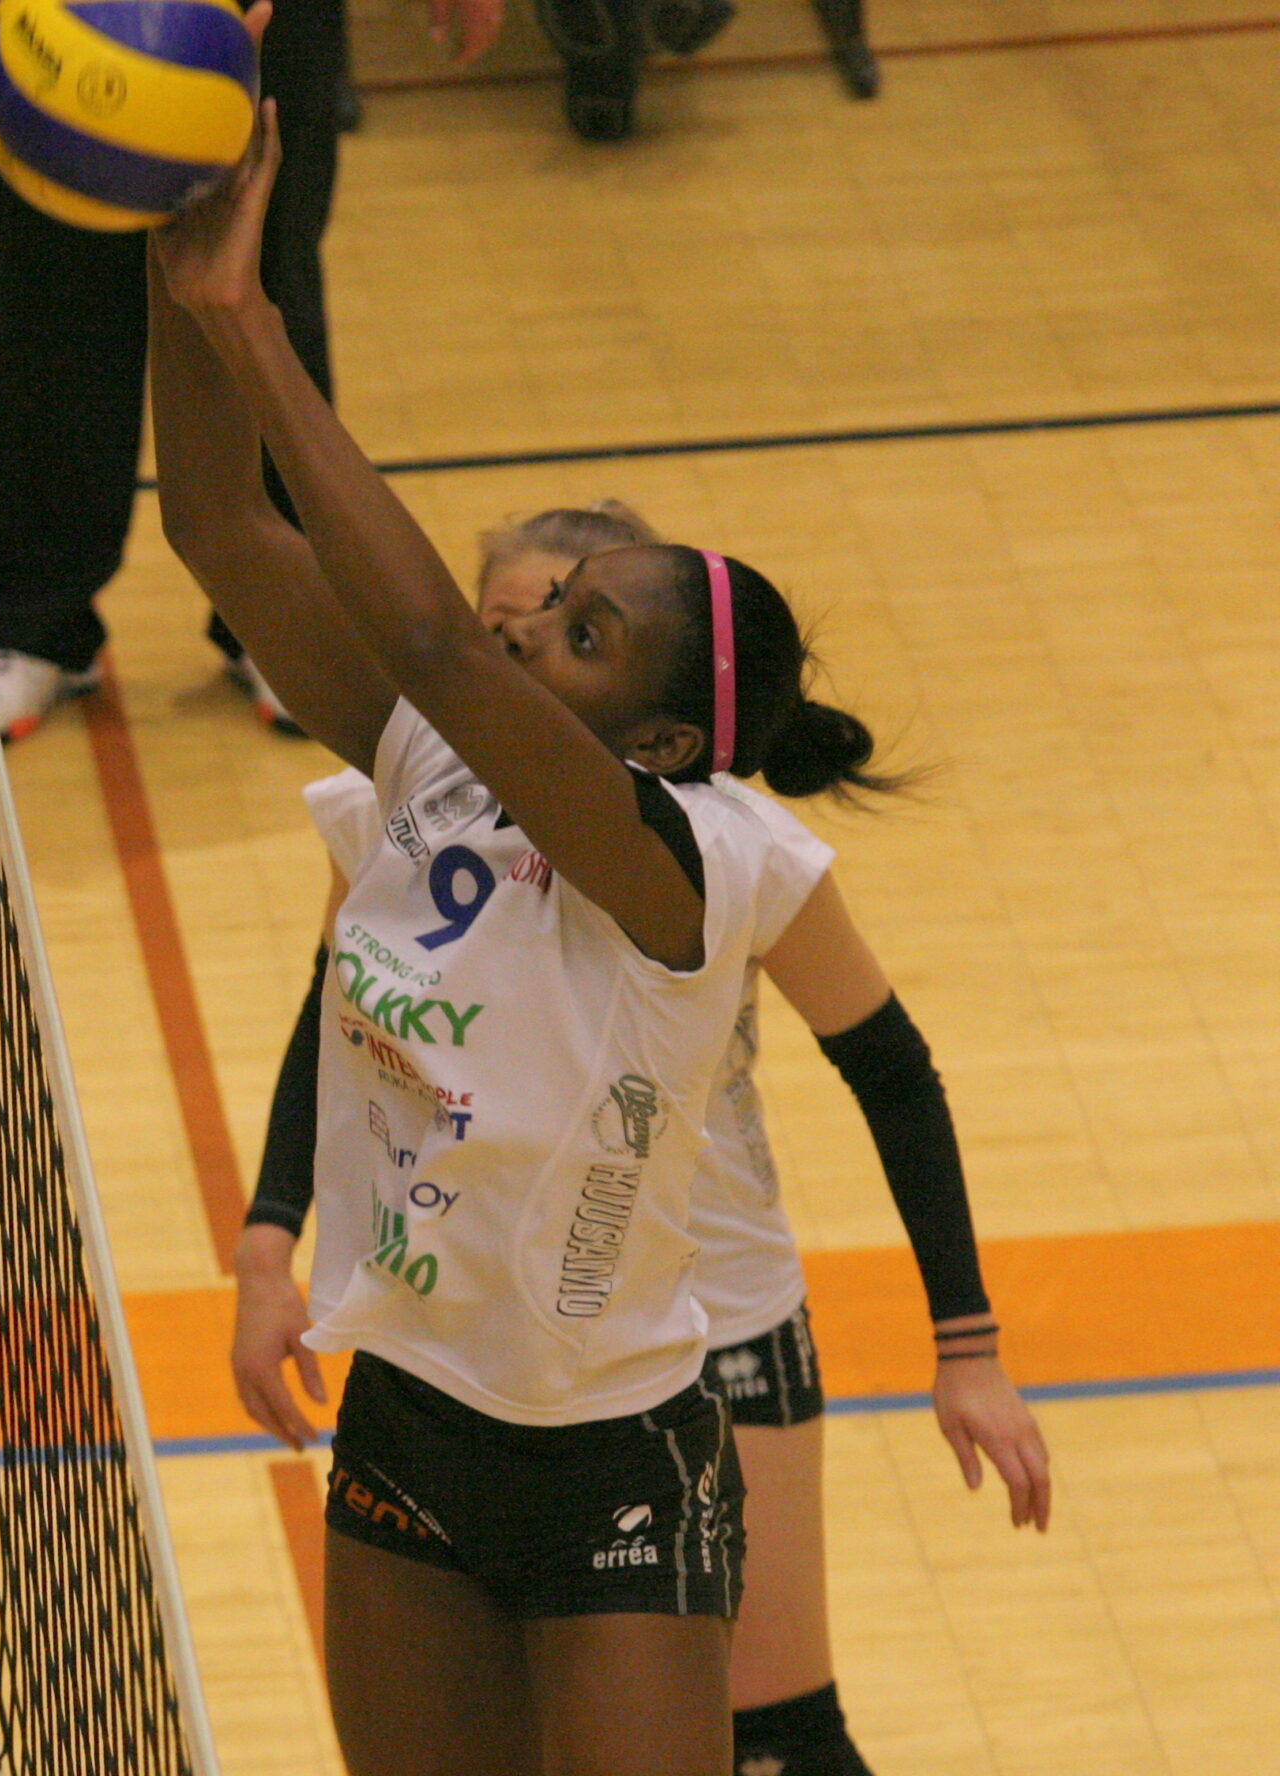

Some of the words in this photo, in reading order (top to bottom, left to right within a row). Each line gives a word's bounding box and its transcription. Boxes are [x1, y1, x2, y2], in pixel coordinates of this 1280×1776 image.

[413, 844, 496, 952] 9
[345, 924, 413, 978] STRONG
[409, 1182, 460, 1217] Oy
[557, 1163, 642, 1318] KUUSAMO
